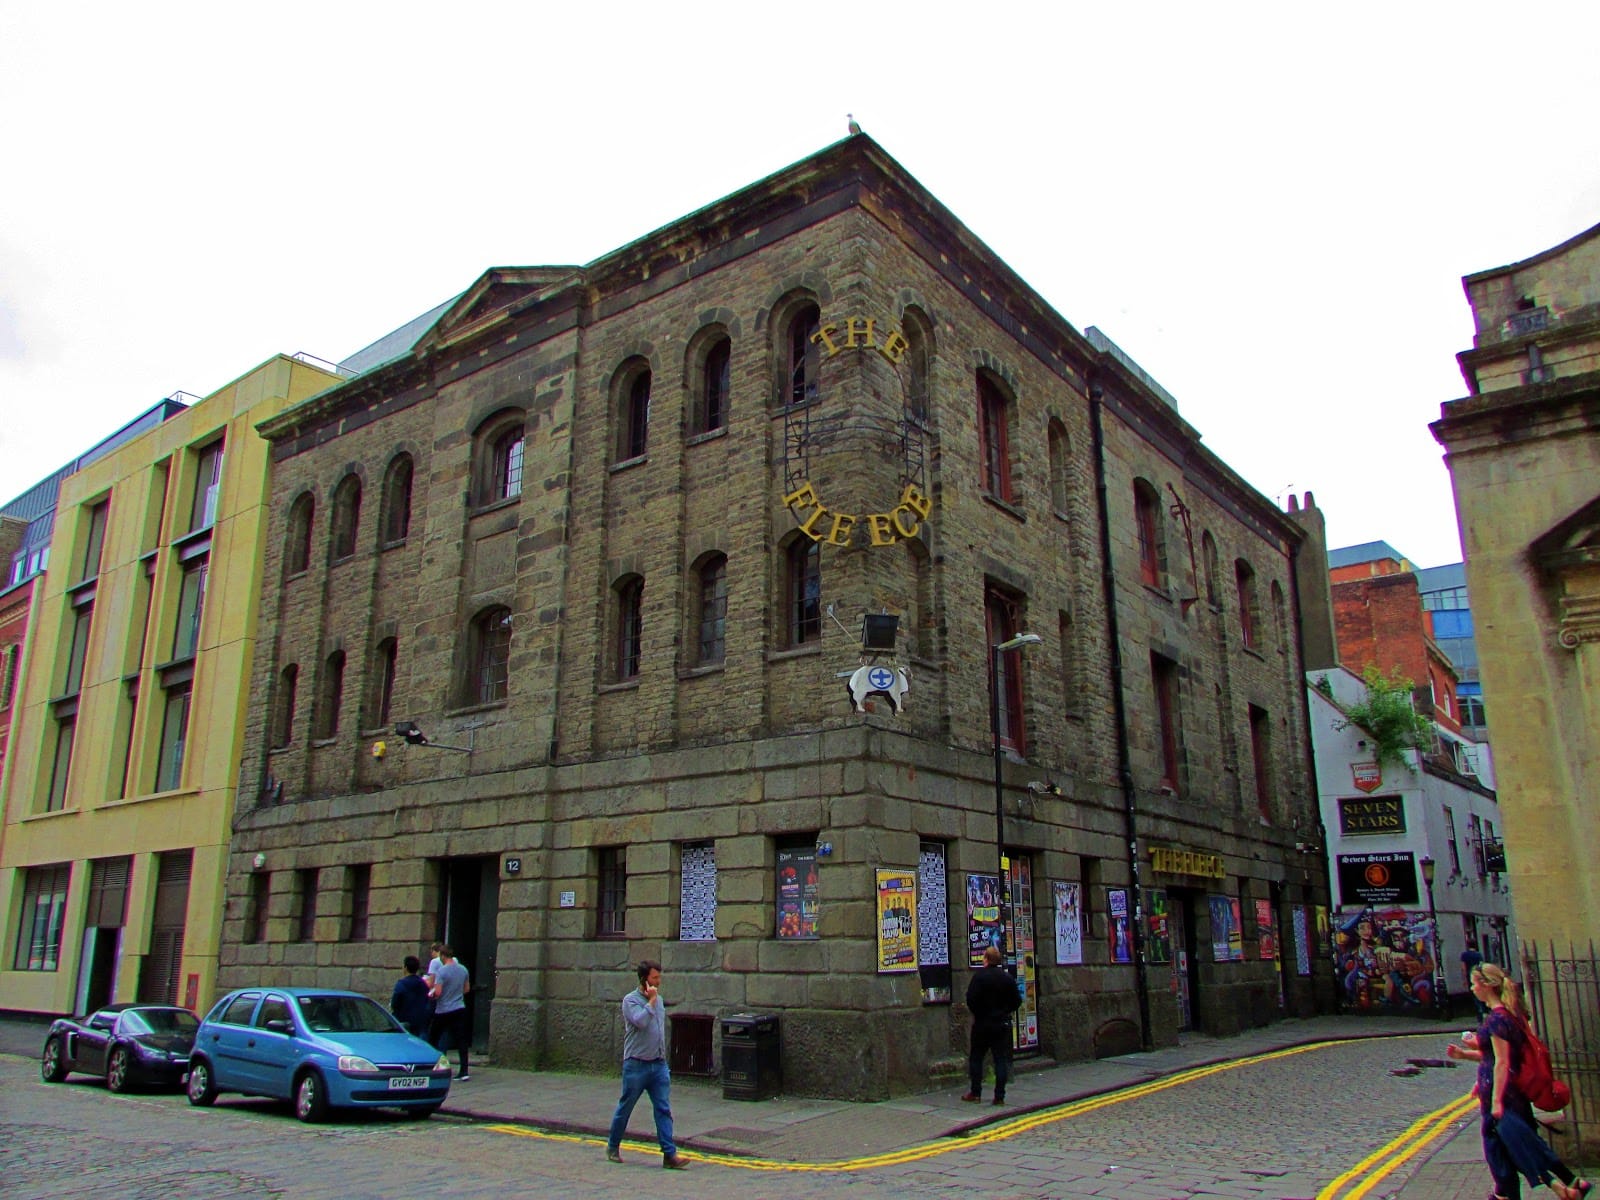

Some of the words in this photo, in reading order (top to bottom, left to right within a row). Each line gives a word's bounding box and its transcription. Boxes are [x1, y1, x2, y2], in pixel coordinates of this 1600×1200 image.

[810, 316, 909, 364] THE
[782, 482, 932, 547] FLEECE
[1343, 802, 1397, 815] SEVEN
[1347, 815, 1398, 828] STARS
[1341, 855, 1366, 864] Seven
[1368, 854, 1391, 863] Stars
[1393, 853, 1409, 862] Inn
[507, 860, 519, 871] 12
[392, 1078, 411, 1087] GY02
